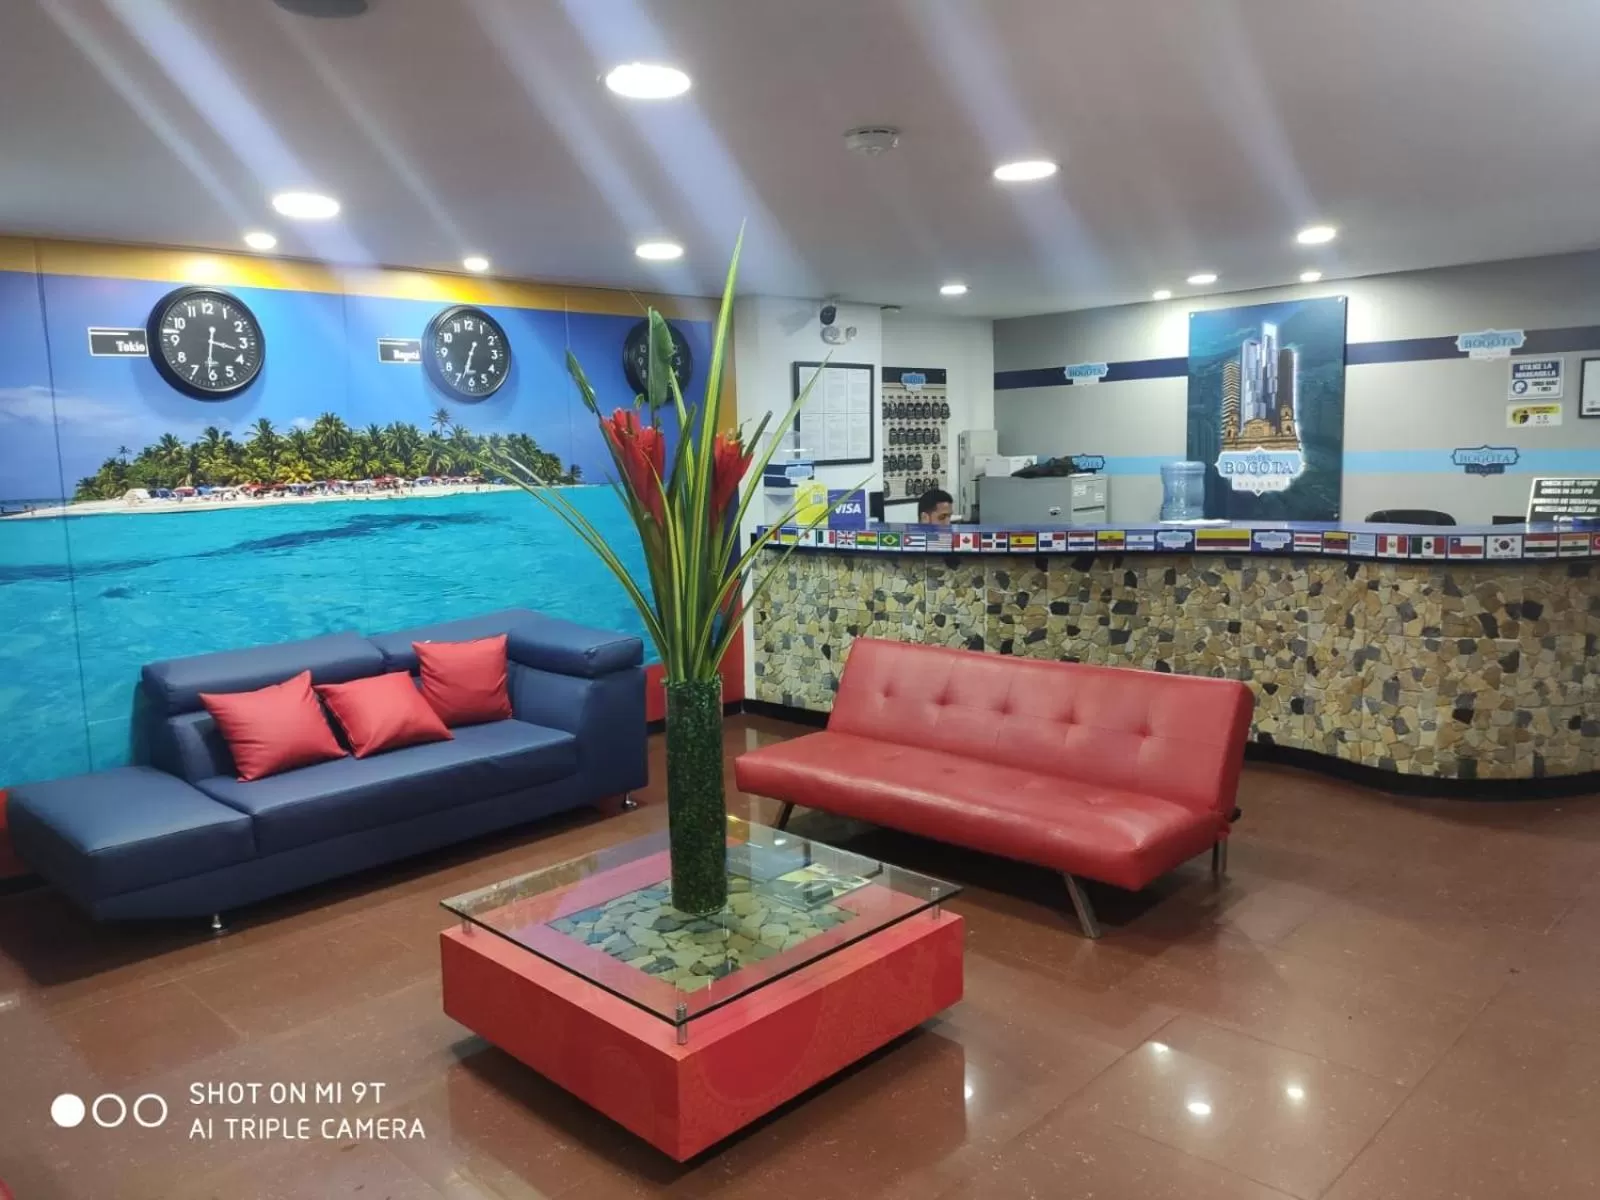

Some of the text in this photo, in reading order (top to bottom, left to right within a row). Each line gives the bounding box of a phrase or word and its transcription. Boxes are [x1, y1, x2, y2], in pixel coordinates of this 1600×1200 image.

[187, 305, 196, 317] 11
[201, 302, 214, 315] 12
[222, 307, 228, 320] 1
[174, 317, 186, 330] 10
[233, 321, 243, 333] 2
[453, 322, 461, 333] 11
[464, 319, 474, 331] 12
[479, 324, 484, 335] 1
[170, 334, 180, 346] 9
[239, 337, 248, 349] 3
[443, 332, 453, 344] 10
[487, 335, 495, 346] 2
[115, 340, 146, 353] Tokio
[440, 347, 448, 358] 9
[177, 352, 187, 364] 8
[235, 354, 244, 365] 4
[491, 350, 498, 360] 3
[190, 364, 200, 376] 7
[225, 366, 234, 378] 5
[445, 362, 453, 372] 8
[487, 363, 495, 373] 4
[208, 369, 218, 381] 6
[455, 373, 462, 383] 7
[480, 374, 488, 384] 5
[468, 378, 475, 387] 6
[1224, 461, 1294, 475] BOGOTA
[835, 503, 862, 514] VISA
